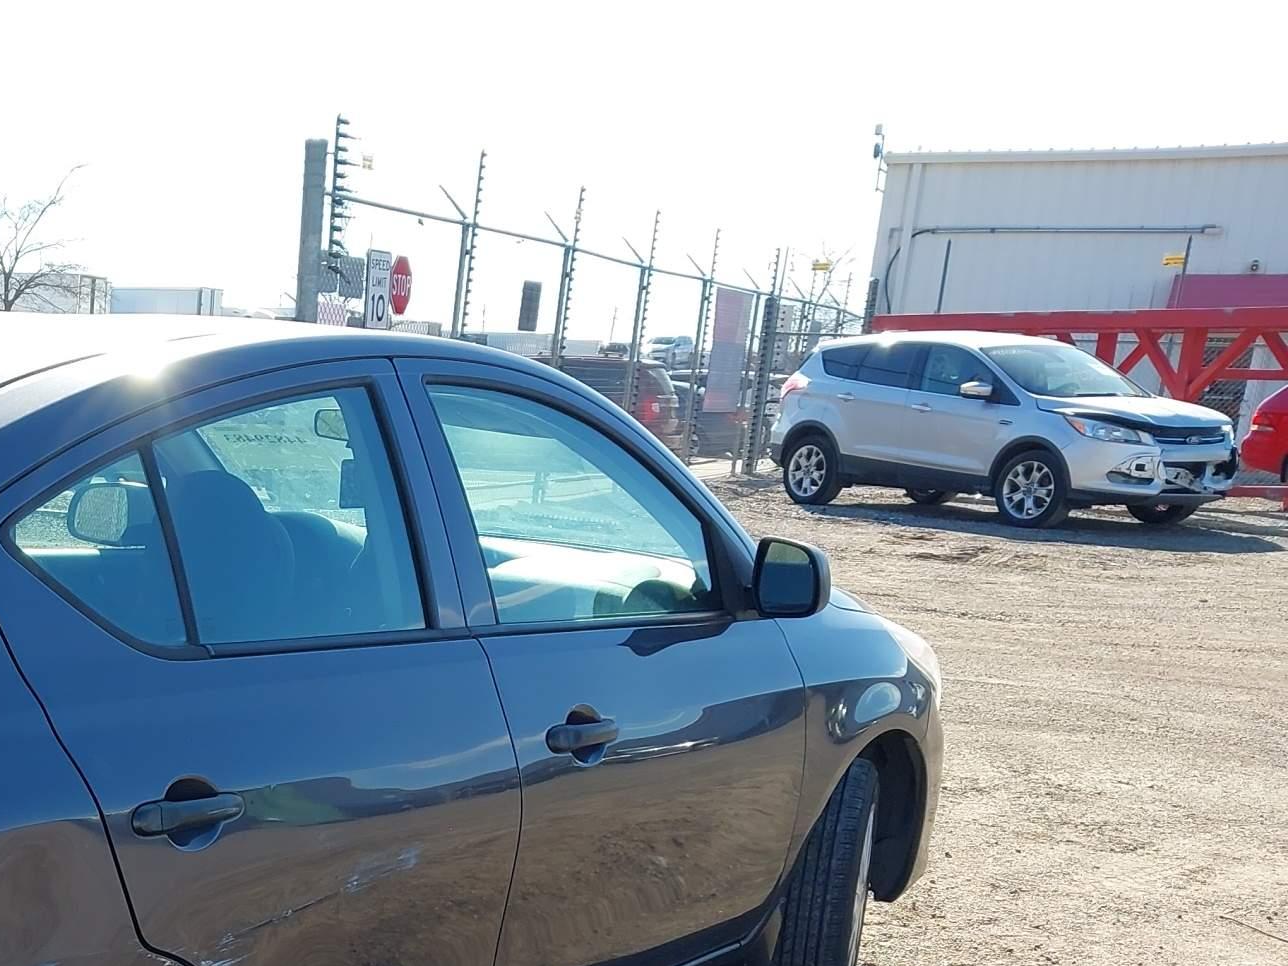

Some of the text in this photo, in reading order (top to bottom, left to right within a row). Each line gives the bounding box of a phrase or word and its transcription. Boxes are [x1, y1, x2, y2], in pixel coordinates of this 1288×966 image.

[370, 258, 390, 272] SPEED
[371, 277, 387, 288] LIMIT
[392, 273, 412, 297] STOP
[370, 293, 386, 322] 10
